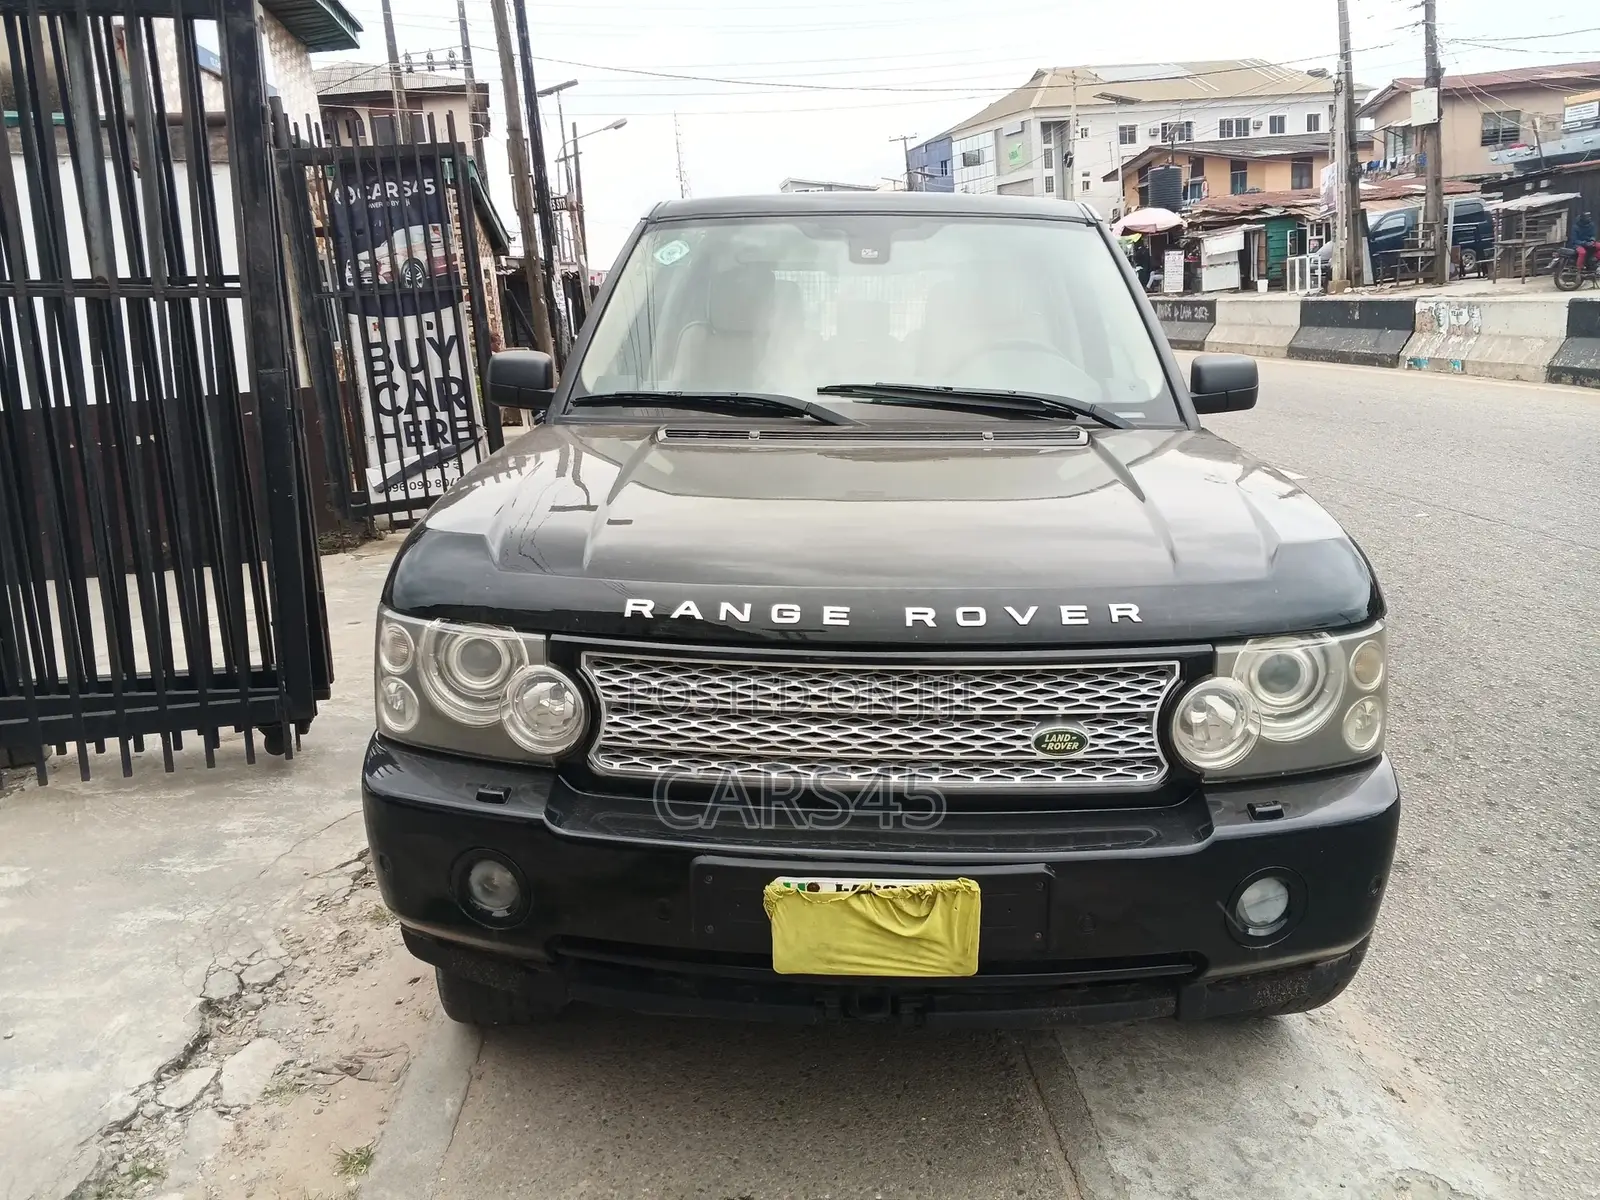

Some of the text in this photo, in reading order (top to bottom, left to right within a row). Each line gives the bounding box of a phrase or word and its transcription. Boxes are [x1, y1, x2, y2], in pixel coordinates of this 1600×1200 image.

[368, 335, 457, 376] BUY
[374, 376, 468, 416] CAR
[379, 416, 475, 450] HERE
[623, 598, 1143, 628] RANGE ROVER
[1044, 733, 1071, 743] LAND
[1046, 742, 1080, 751] ROVER
